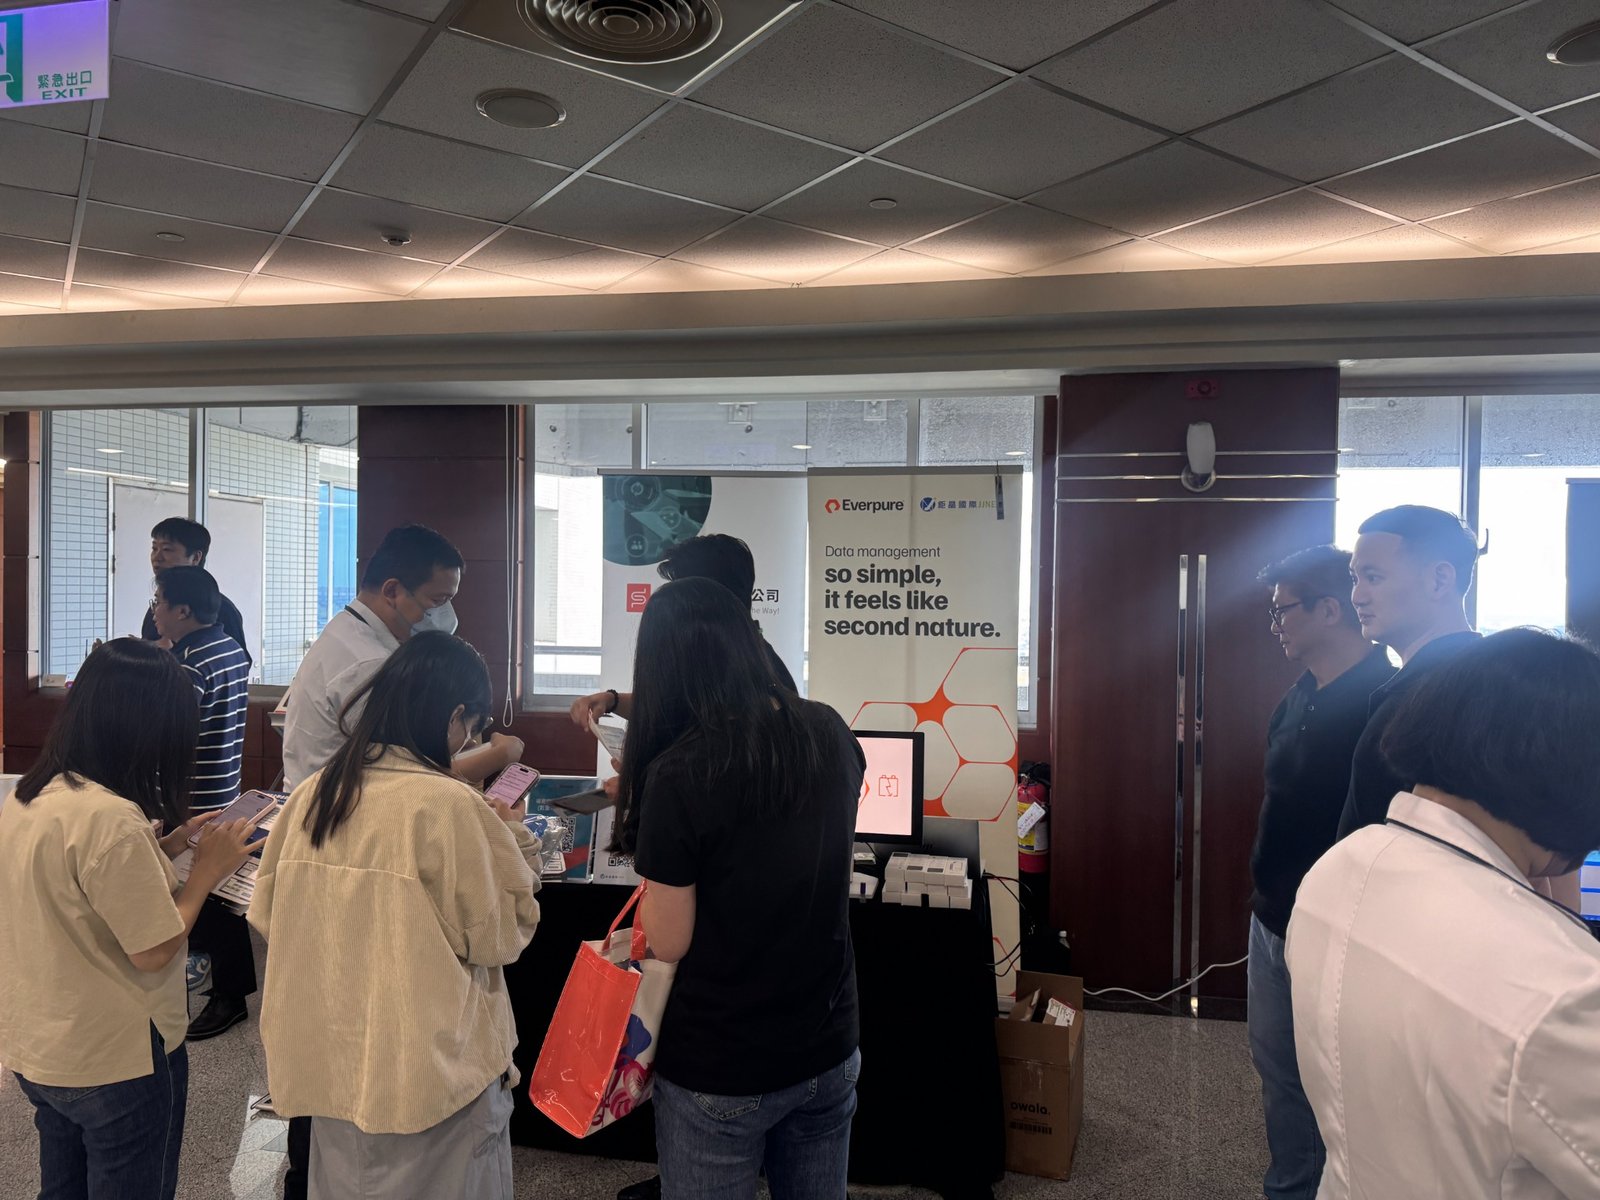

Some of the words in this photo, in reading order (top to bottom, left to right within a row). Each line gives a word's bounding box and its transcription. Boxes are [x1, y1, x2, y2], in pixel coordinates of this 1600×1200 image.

[37, 70, 92, 88] 緊急出口
[42, 87, 87, 100] EXIT
[842, 499, 904, 513] Everpure
[825, 546, 854, 557] Data
[857, 546, 941, 560] management
[825, 567, 852, 583] so
[856, 564, 942, 588] simple,
[752, 589, 779, 603] 公司
[825, 589, 840, 609] it
[844, 590, 901, 610] feels
[906, 590, 949, 610] like
[762, 607, 780, 616] Way!
[824, 617, 909, 636] second
[915, 618, 1001, 638] nature.
